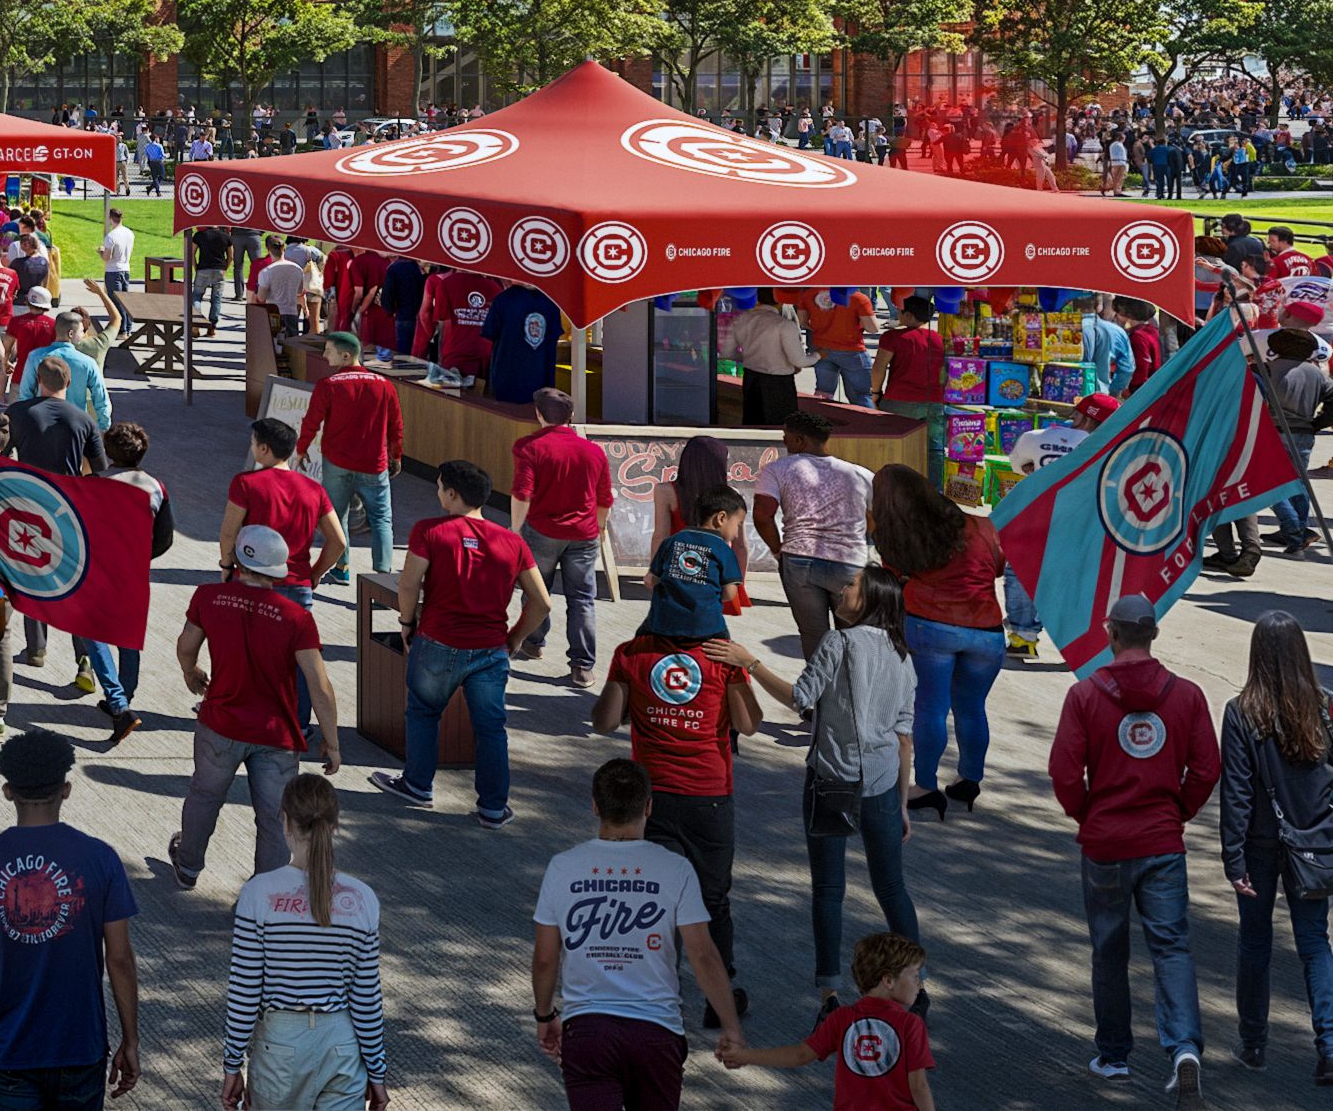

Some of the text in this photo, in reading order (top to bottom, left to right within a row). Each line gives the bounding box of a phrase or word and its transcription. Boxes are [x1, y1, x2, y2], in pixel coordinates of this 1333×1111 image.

[53, 148, 93, 160] GT-ON
[678, 247, 712, 257] CHICAGO
[712, 247, 731, 257] FIRE
[861, 247, 896, 257] CHICAGO
[896, 247, 915, 257] FIRE
[1037, 247, 1071, 256] CHICAGO
[1072, 247, 1090, 256] FIRE
[618, 446, 779, 502] Spal
[213, 599, 283, 622] FOOTBALL CLUB
[217, 594, 280, 614] CHICAGO FIRE
[646, 706, 705, 720] CHICAGO
[650, 718, 701, 731] FIRE FC
[44, 861, 73, 898] FIRE
[569, 879, 661, 895] CHICAGO
[38, 902, 71, 943] FOREVER
[564, 895, 667, 951] Fire
[646, 933, 663, 952] C
